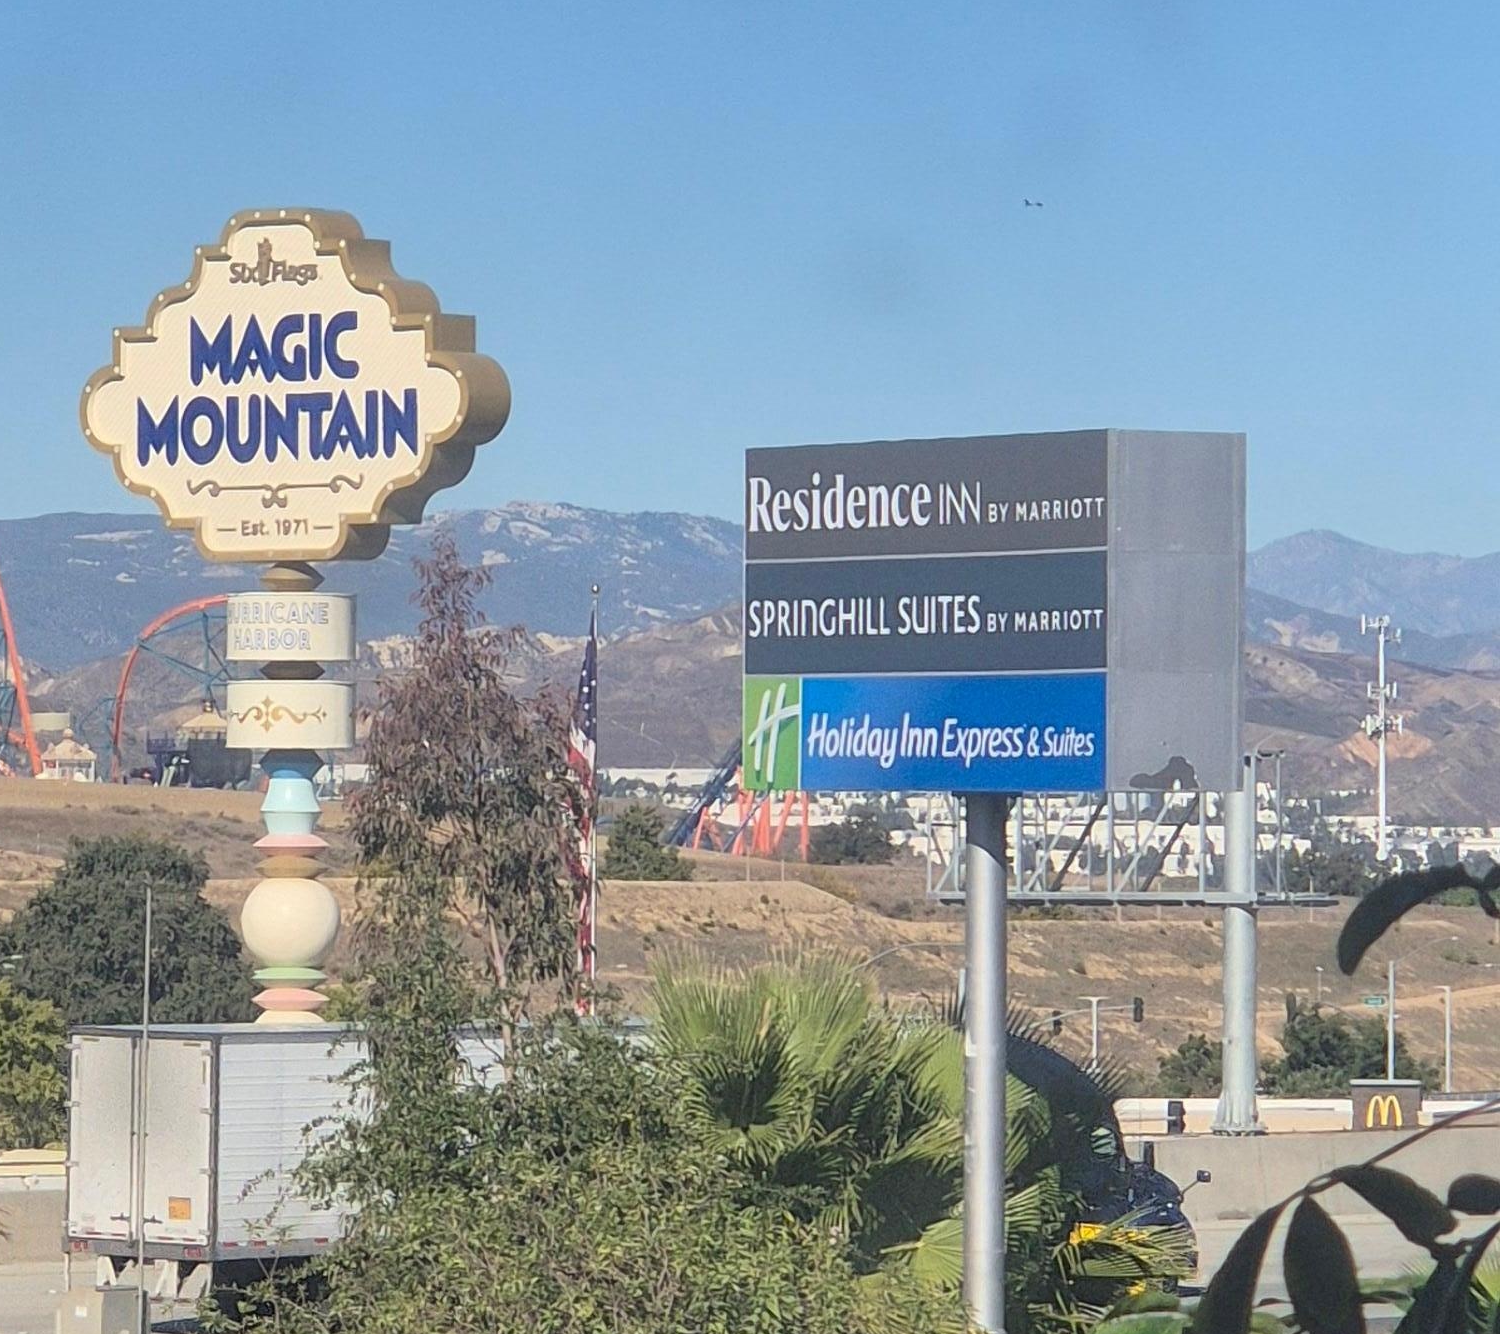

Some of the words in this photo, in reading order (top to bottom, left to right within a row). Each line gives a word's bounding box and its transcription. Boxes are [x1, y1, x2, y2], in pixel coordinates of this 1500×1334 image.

[271, 259, 318, 286] Flags
[190, 311, 360, 386] MAGIC
[137, 388, 418, 467] MOUNTAIN
[240, 518, 269, 536] Est.
[275, 518, 309, 536] 1971
[748, 472, 932, 532] Residence
[938, 481, 981, 526] INN
[987, 501, 1009, 523] BY
[1015, 497, 1106, 523] MARRIOTT
[234, 627, 312, 651] HARBOR
[748, 596, 892, 638] SPRINGHILL
[897, 595, 981, 635] SUITES
[986, 613, 1009, 633] BY
[1014, 609, 1105, 632] MARRIOTT
[807, 712, 899, 769] Holiday
[900, 712, 938, 758] Inn
[941, 717, 1025, 769] Express
[1027, 726, 1040, 758] &
[1042, 726, 1095, 758] Suites
